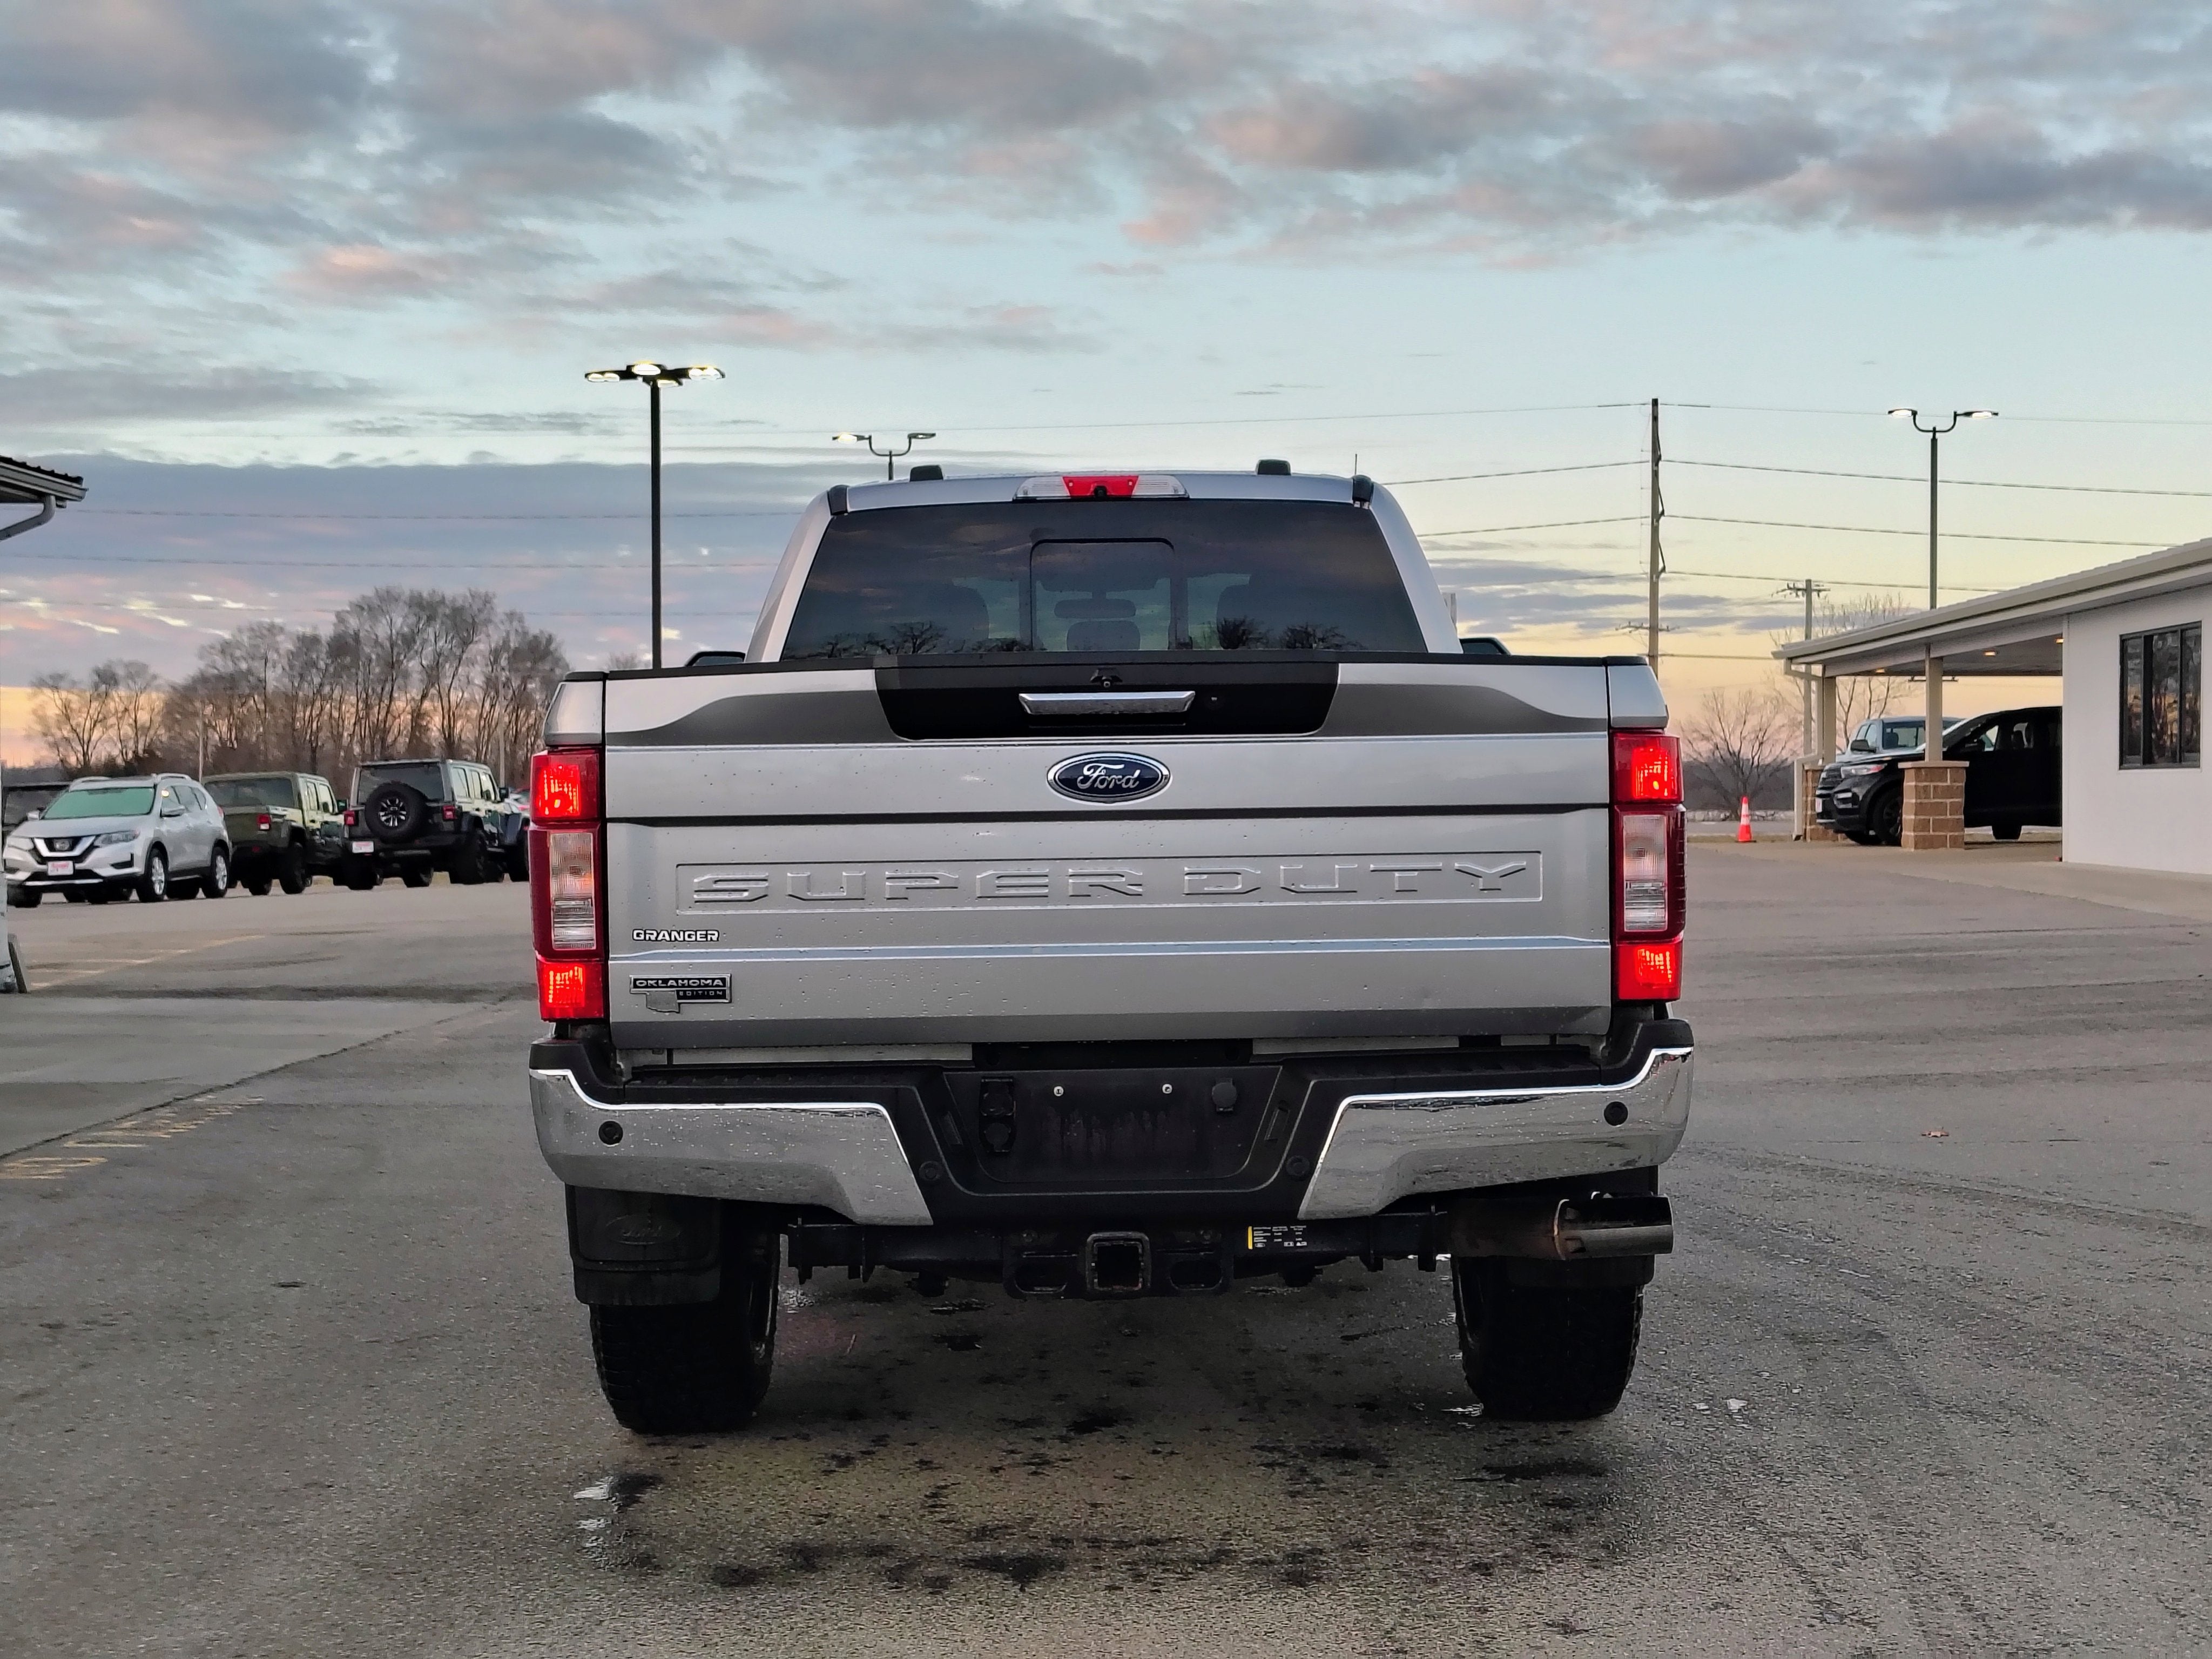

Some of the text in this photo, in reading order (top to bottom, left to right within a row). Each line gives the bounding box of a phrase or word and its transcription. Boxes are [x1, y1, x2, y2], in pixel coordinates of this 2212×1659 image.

[1077, 763, 1141, 789] Ford
[694, 862, 1526, 903] SUPER DUTY
[632, 929, 719, 941] GRANGER
